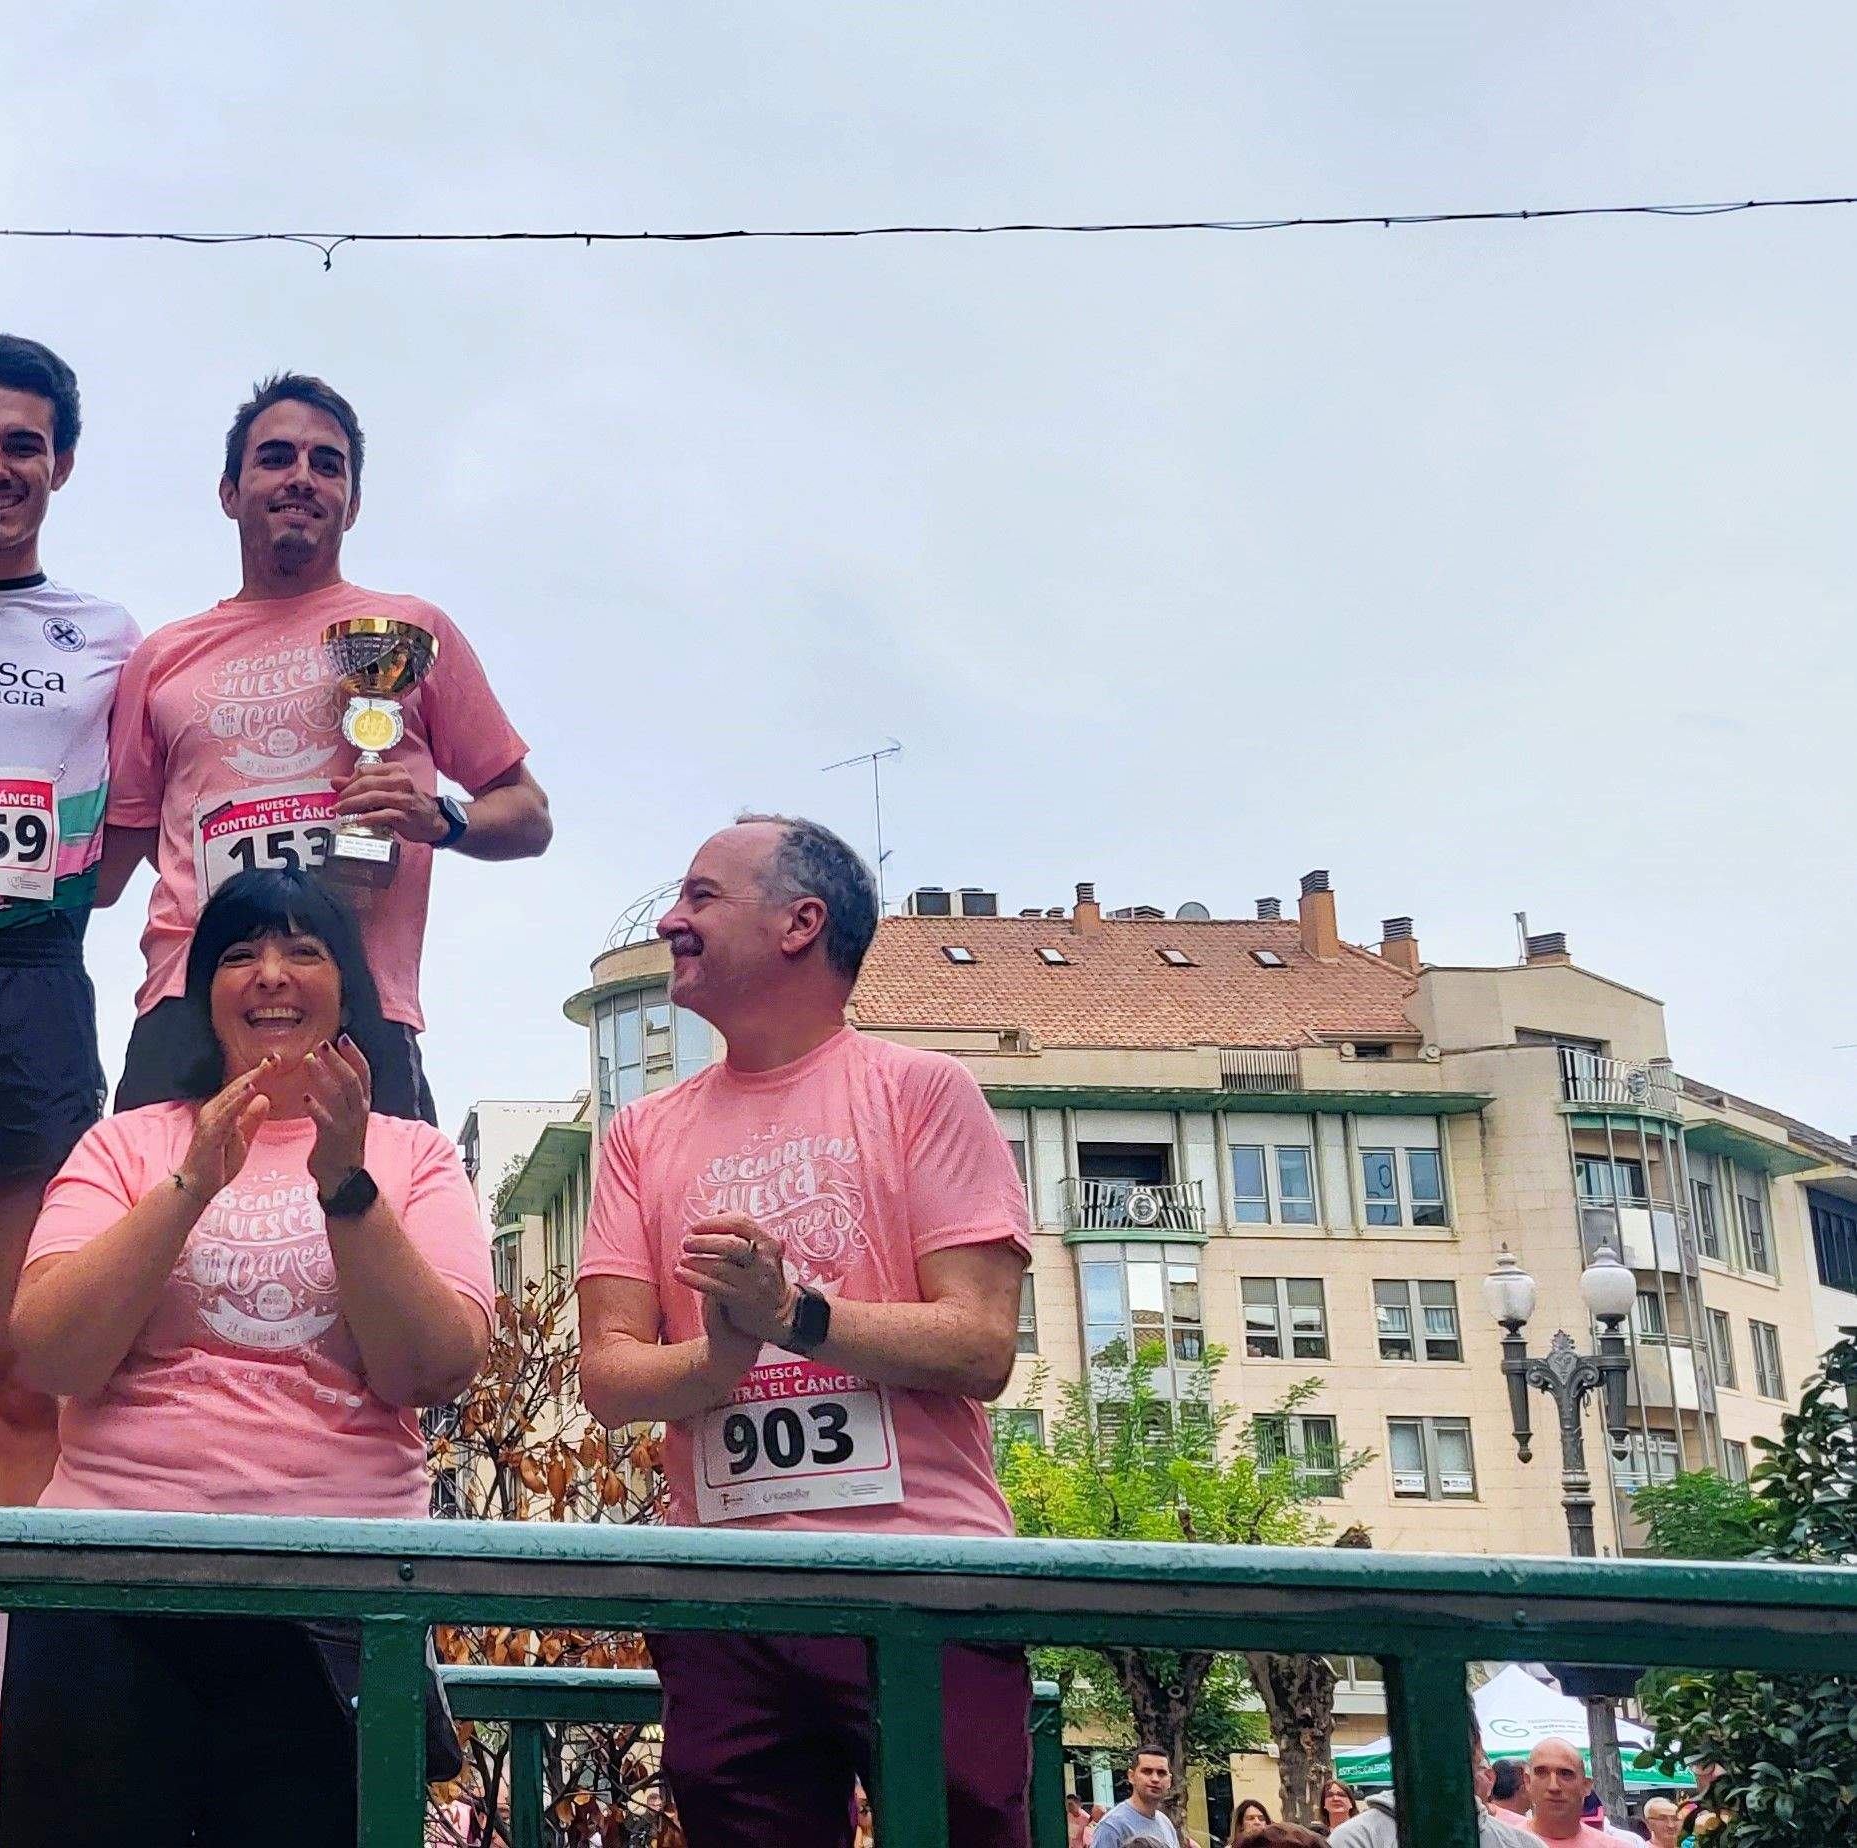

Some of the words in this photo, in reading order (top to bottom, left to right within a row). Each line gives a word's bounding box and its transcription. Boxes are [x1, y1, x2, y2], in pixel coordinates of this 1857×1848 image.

[256, 798, 300, 812] HUESCA
[210, 816, 266, 836] CONTRA
[272, 812, 289, 824] EL
[293, 805, 335, 821] CÁNC
[228, 827, 330, 869] 153
[750, 1366, 802, 1382] HUESCA
[735, 1386, 766, 1402] TRA
[770, 1383, 791, 1397] EL
[723, 1402, 854, 1475] 903
